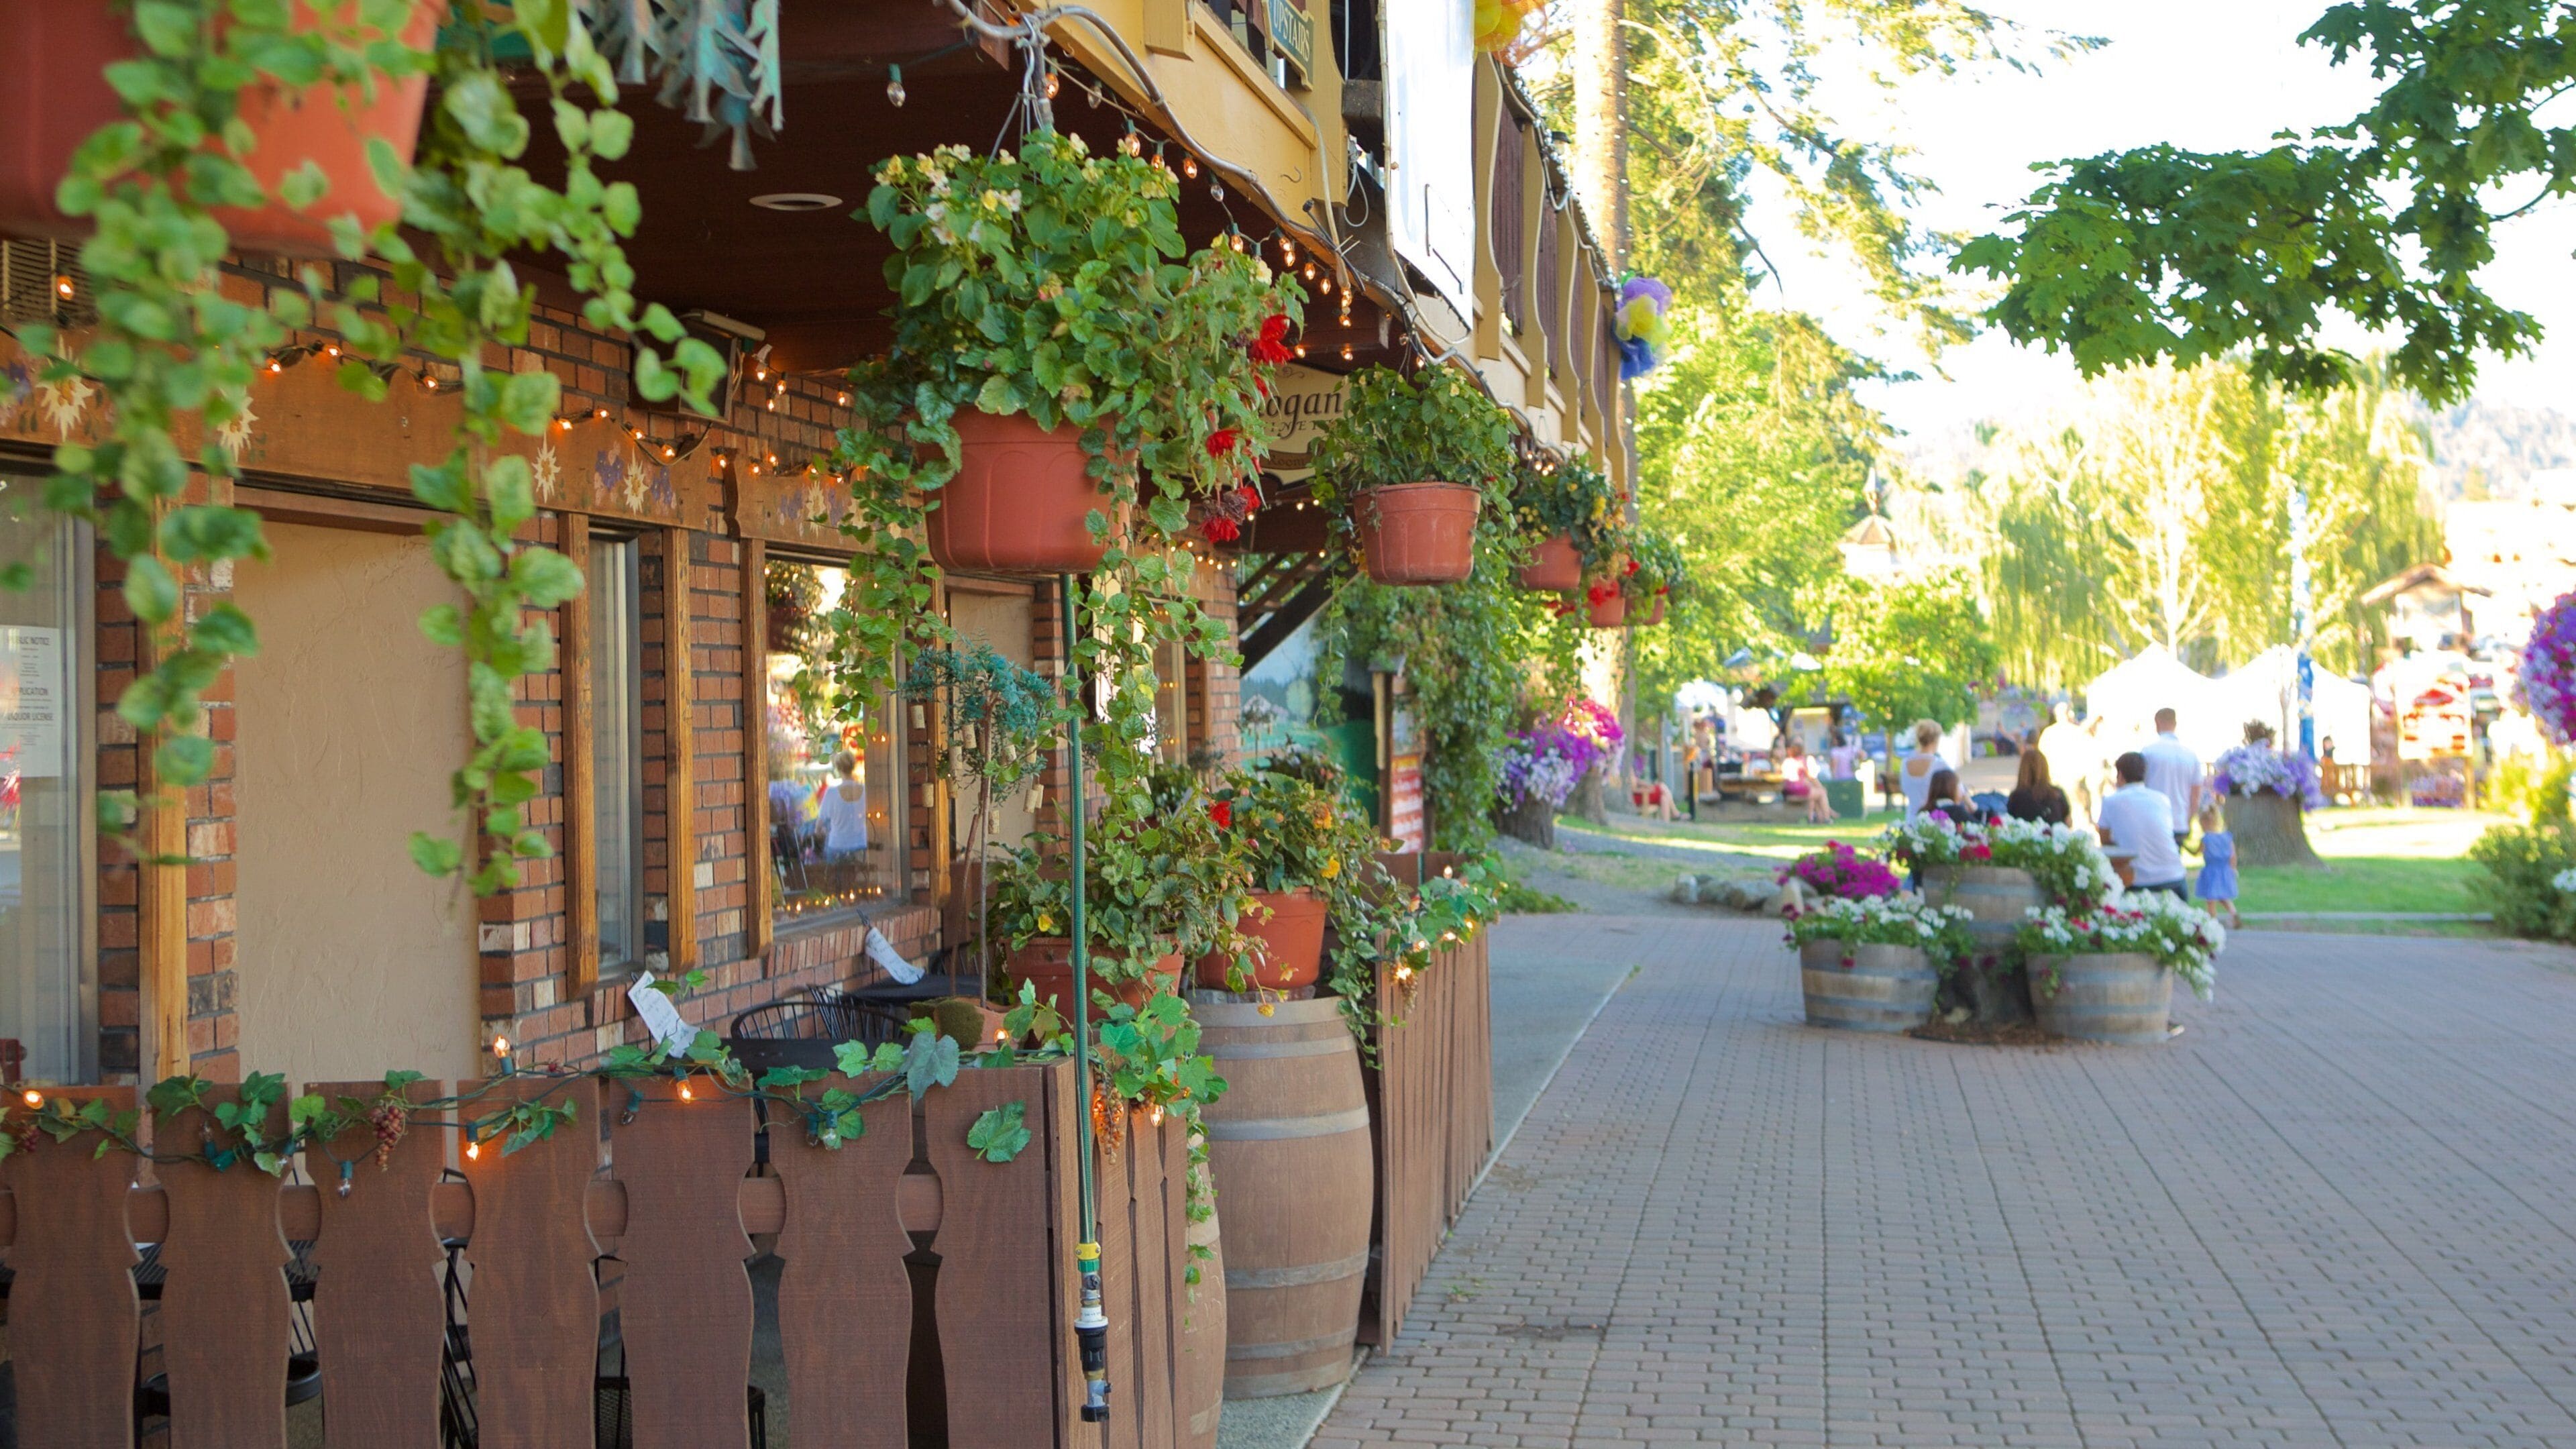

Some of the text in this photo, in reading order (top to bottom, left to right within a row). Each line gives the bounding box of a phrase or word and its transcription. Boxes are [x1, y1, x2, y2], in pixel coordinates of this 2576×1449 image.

[1273, 0, 1310, 62] UPSTAIRS
[1258, 392, 1342, 439] ogan
[30, 636, 50, 645] NOTICE
[32, 712, 54, 721] LICENSE
